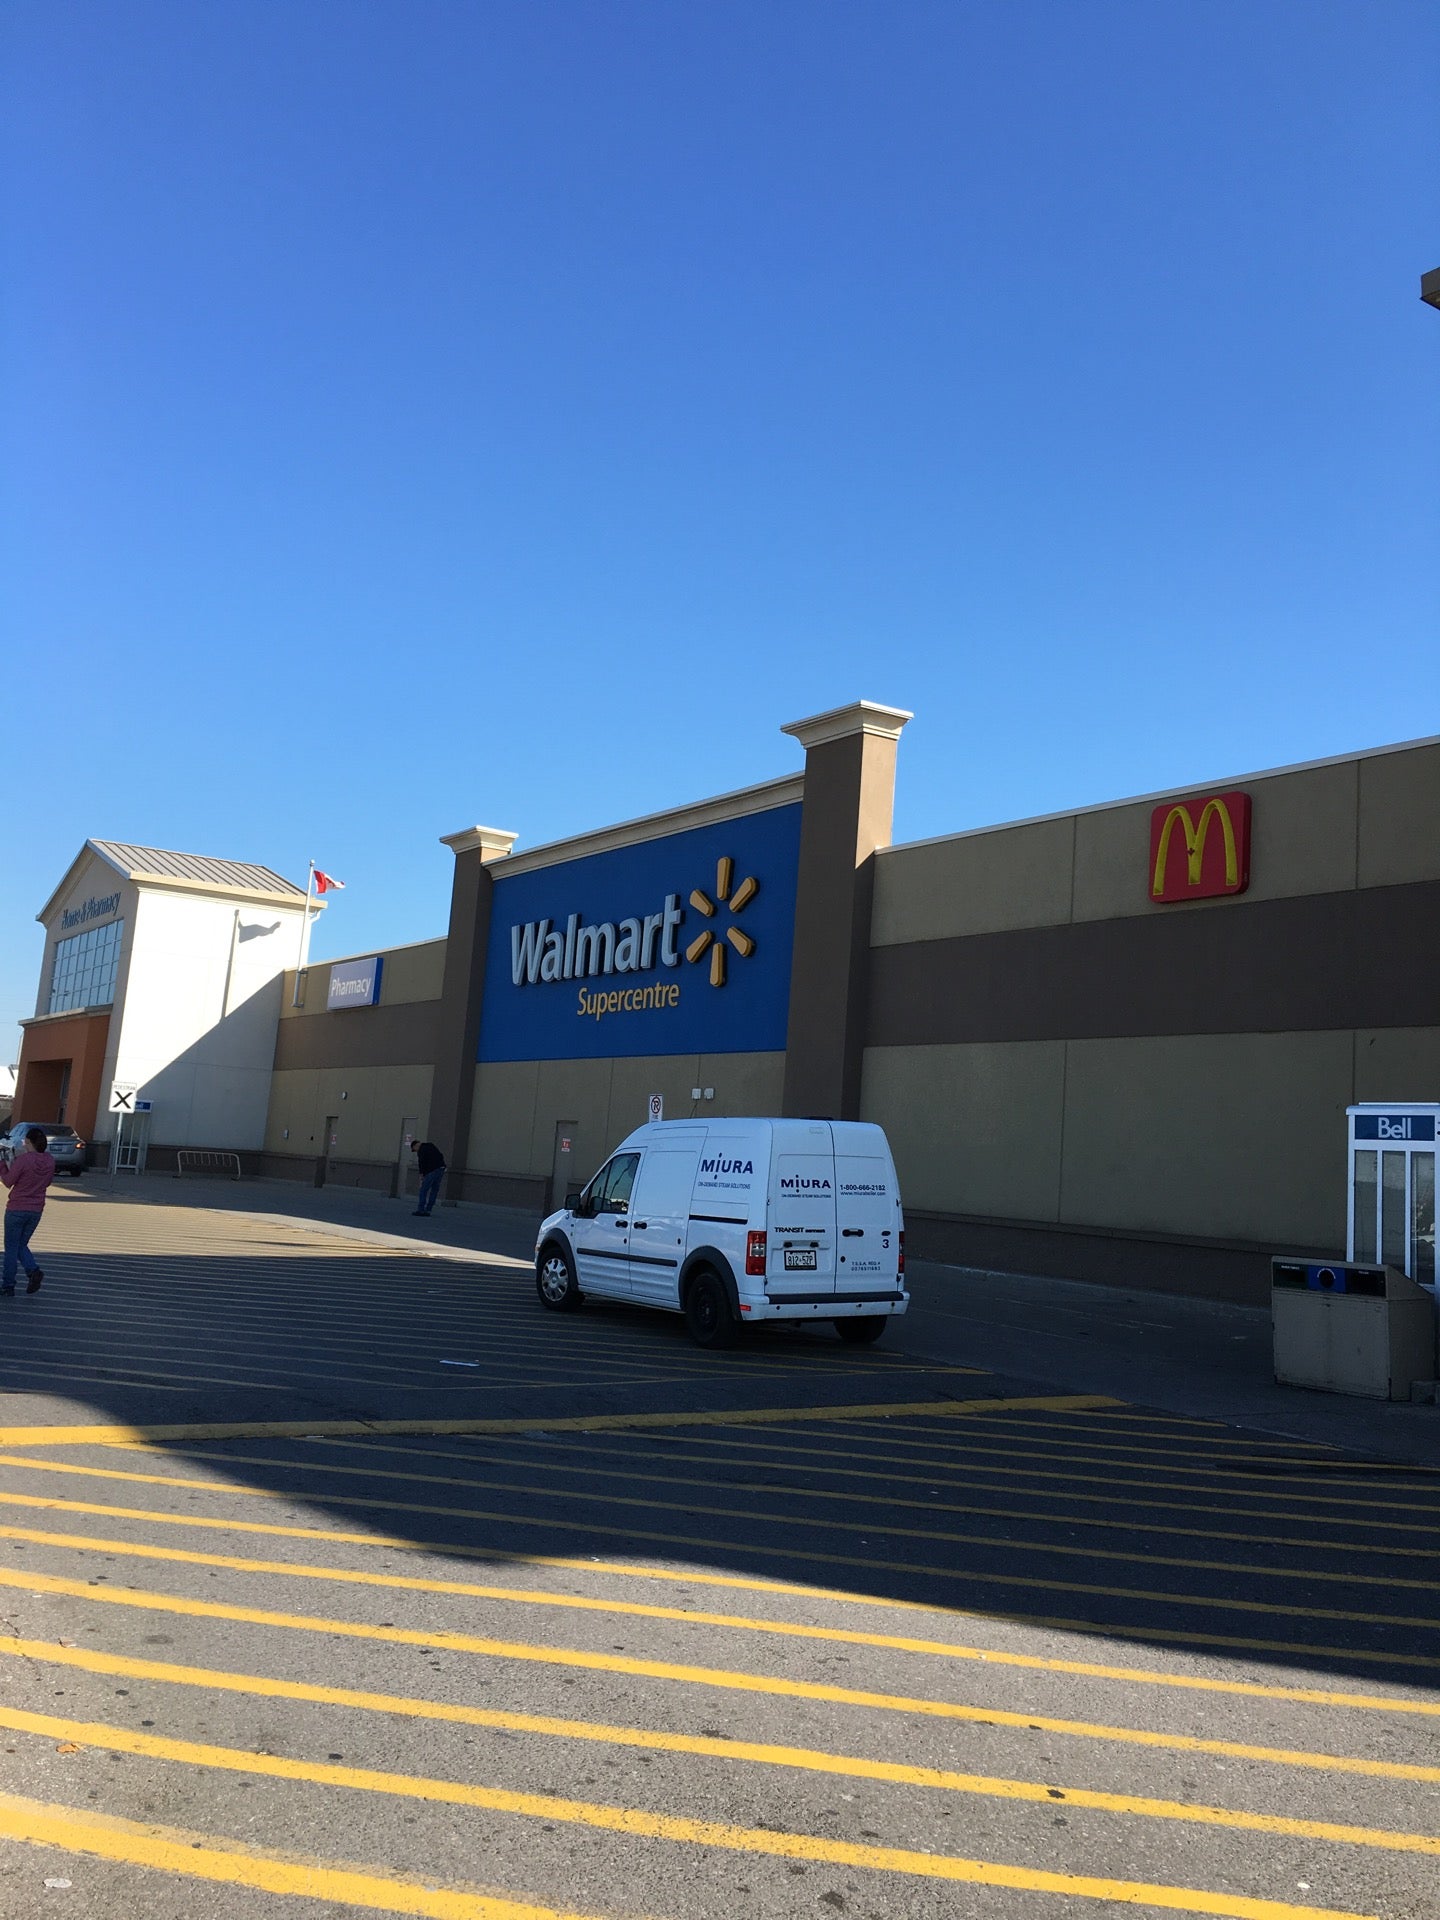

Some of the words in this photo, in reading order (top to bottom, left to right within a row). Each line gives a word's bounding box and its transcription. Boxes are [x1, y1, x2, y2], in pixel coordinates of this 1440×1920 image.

[86, 891, 121, 920] Pharmacy
[511, 894, 681, 985] Walmart
[330, 977, 372, 997] Pharmacy
[577, 981, 680, 1021] Supercentre
[1378, 1117, 1412, 1139] Bell
[882, 1239, 889, 1249] 3
